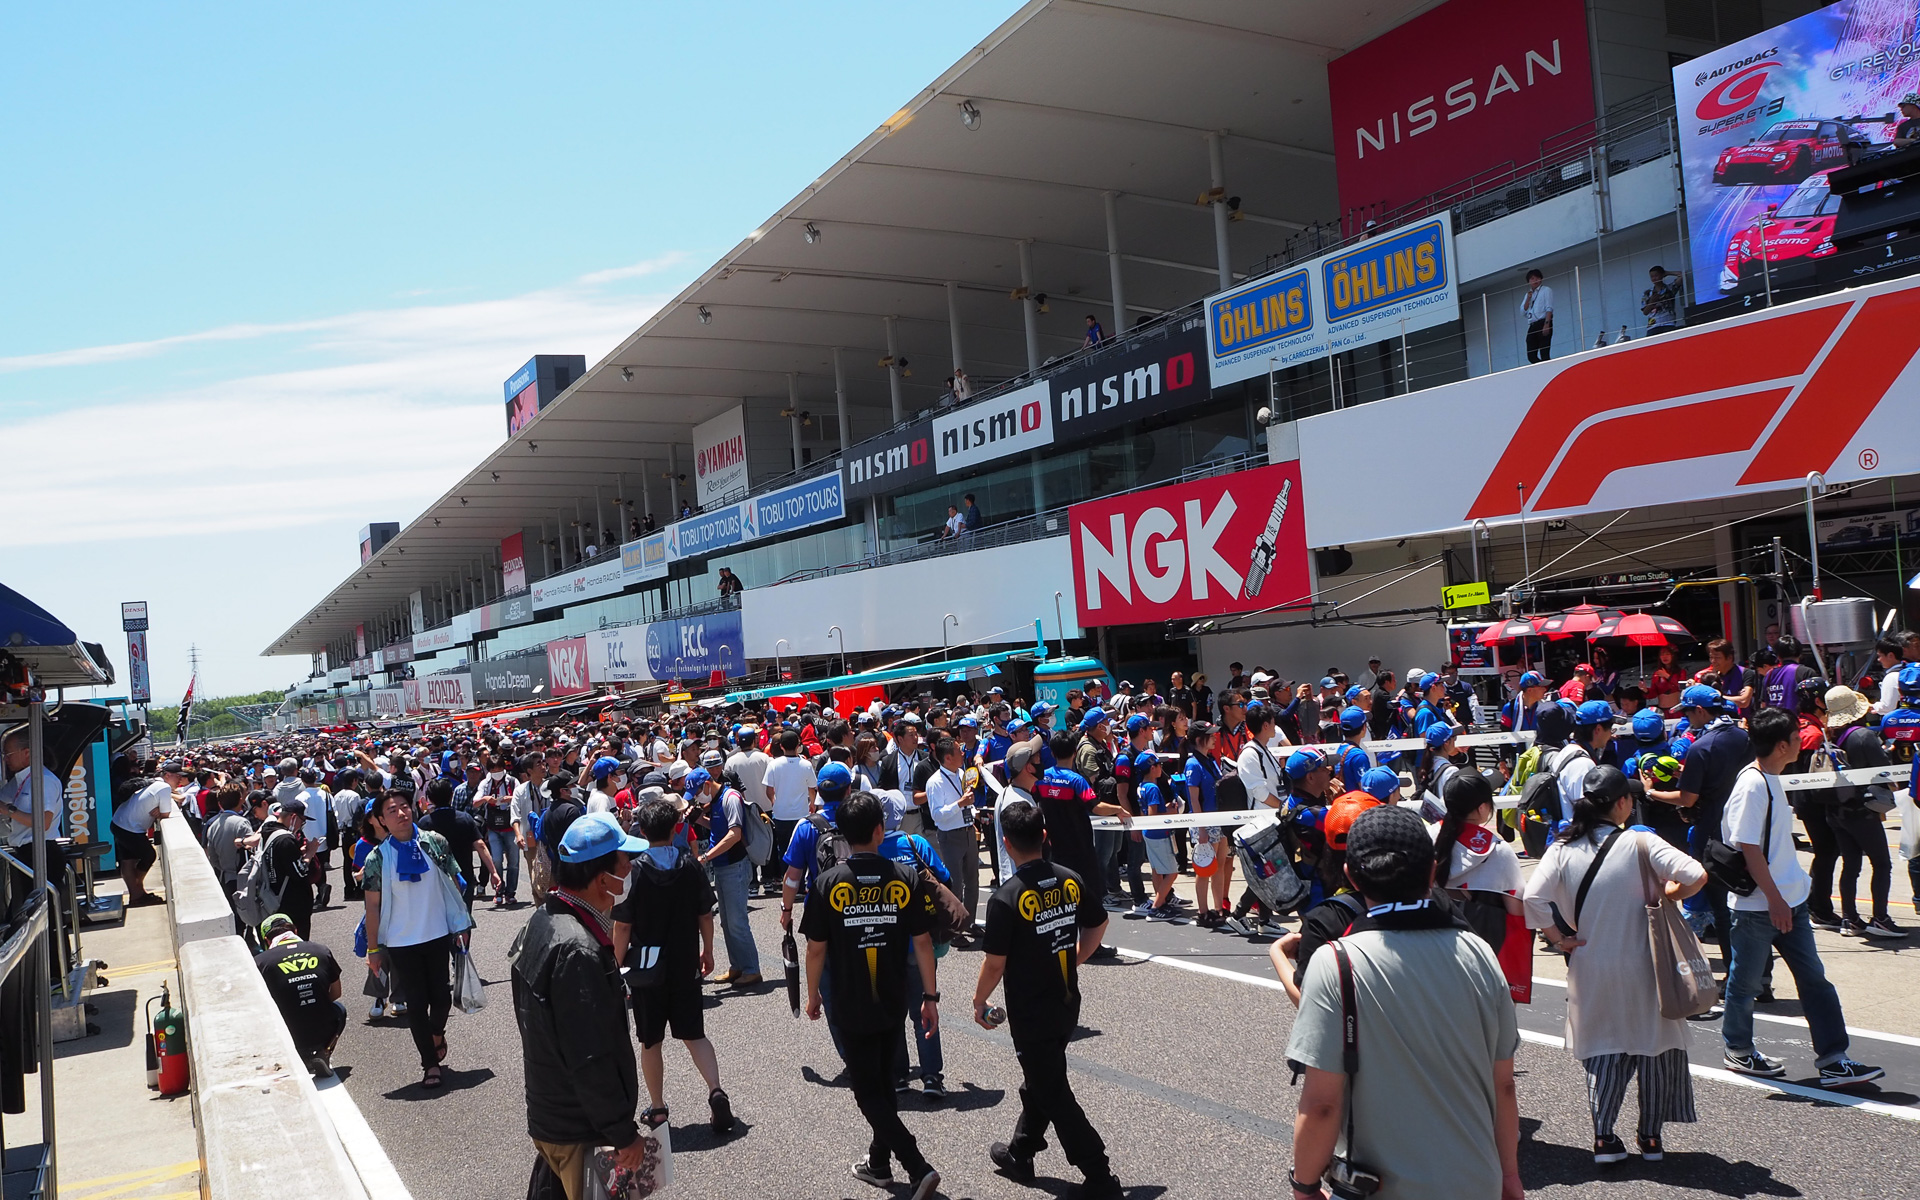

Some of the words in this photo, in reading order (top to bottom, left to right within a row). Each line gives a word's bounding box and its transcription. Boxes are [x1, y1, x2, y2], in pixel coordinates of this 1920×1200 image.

[1708, 46, 1779, 80] AUTOBACS
[1830, 62, 1855, 81] GT
[1356, 39, 1562, 160] NISSAN
[1698, 113, 1744, 136] SUPER
[1747, 105, 1767, 119] GT
[1823, 145, 1844, 159] MOTUL
[1759, 237, 1810, 247] Astemo
[1886, 245, 1894, 258] 1
[1333, 240, 1437, 310] ÖHLINS
[1327, 319, 1360, 335] ADVANCED
[1361, 306, 1402, 325] SUSPENSION
[1403, 291, 1449, 312] TECHNOLOGY
[1743, 295, 1752, 307] 2
[1219, 286, 1304, 347] ÖHLINS
[1214, 356, 1242, 369] ADVANCED
[1243, 345, 1276, 361] SUSPENSION
[1277, 332, 1315, 350] TECHNOLOGY
[1281, 355, 1289, 364] by
[1288, 344, 1325, 362] CARROZZERIA
[1325, 339, 1343, 351] JPAN
[1355, 332, 1367, 341] Ltd.
[510, 368, 530, 395] Panasonic
[1061, 351, 1196, 422] nismo
[942, 400, 1042, 457] nismo
[706, 435, 745, 474] YAMAHA
[850, 437, 928, 484] nismo
[706, 477, 720, 495] Revs
[729, 468, 742, 481] Heart
[760, 504, 785, 526] TOBU
[786, 498, 805, 519] TOP
[805, 485, 839, 514] TOURS
[681, 529, 700, 548] TOBU
[700, 524, 715, 543] TOP
[714, 515, 740, 537] TOURS
[1080, 489, 1244, 610] NGK
[503, 556, 524, 574] HONDA
[602, 570, 621, 584] RACING
[1629, 573, 1647, 582] Team
[1647, 571, 1669, 580] Studie
[556, 583, 572, 595] RACING
[1443, 587, 1455, 608] 6
[601, 630, 619, 639] CLUTCH
[681, 623, 709, 658] F.C.C.
[607, 641, 628, 669] F.C.C.
[1471, 643, 1488, 651] Studie
[549, 644, 581, 689] NGK
[678, 662, 701, 673] technology
[485, 671, 506, 689] Honda
[506, 670, 531, 689] Dream
[375, 692, 399, 714] HONDA
[427, 679, 464, 705] HONDA
[1903, 746, 1910, 756] 1
[395, 778, 413, 788] STAFF
[1051, 777, 1071, 785] SUBARU
[1802, 777, 1830, 785] SUBARU
[63, 765, 91, 837] yogibo
[859, 886, 881, 903] 30
[1043, 888, 1061, 909] 30
[843, 904, 881, 915] COROLLA
[881, 903, 898, 913] MIE
[288, 973, 318, 984] HONDA
[1345, 1015, 1354, 1043] Canon
